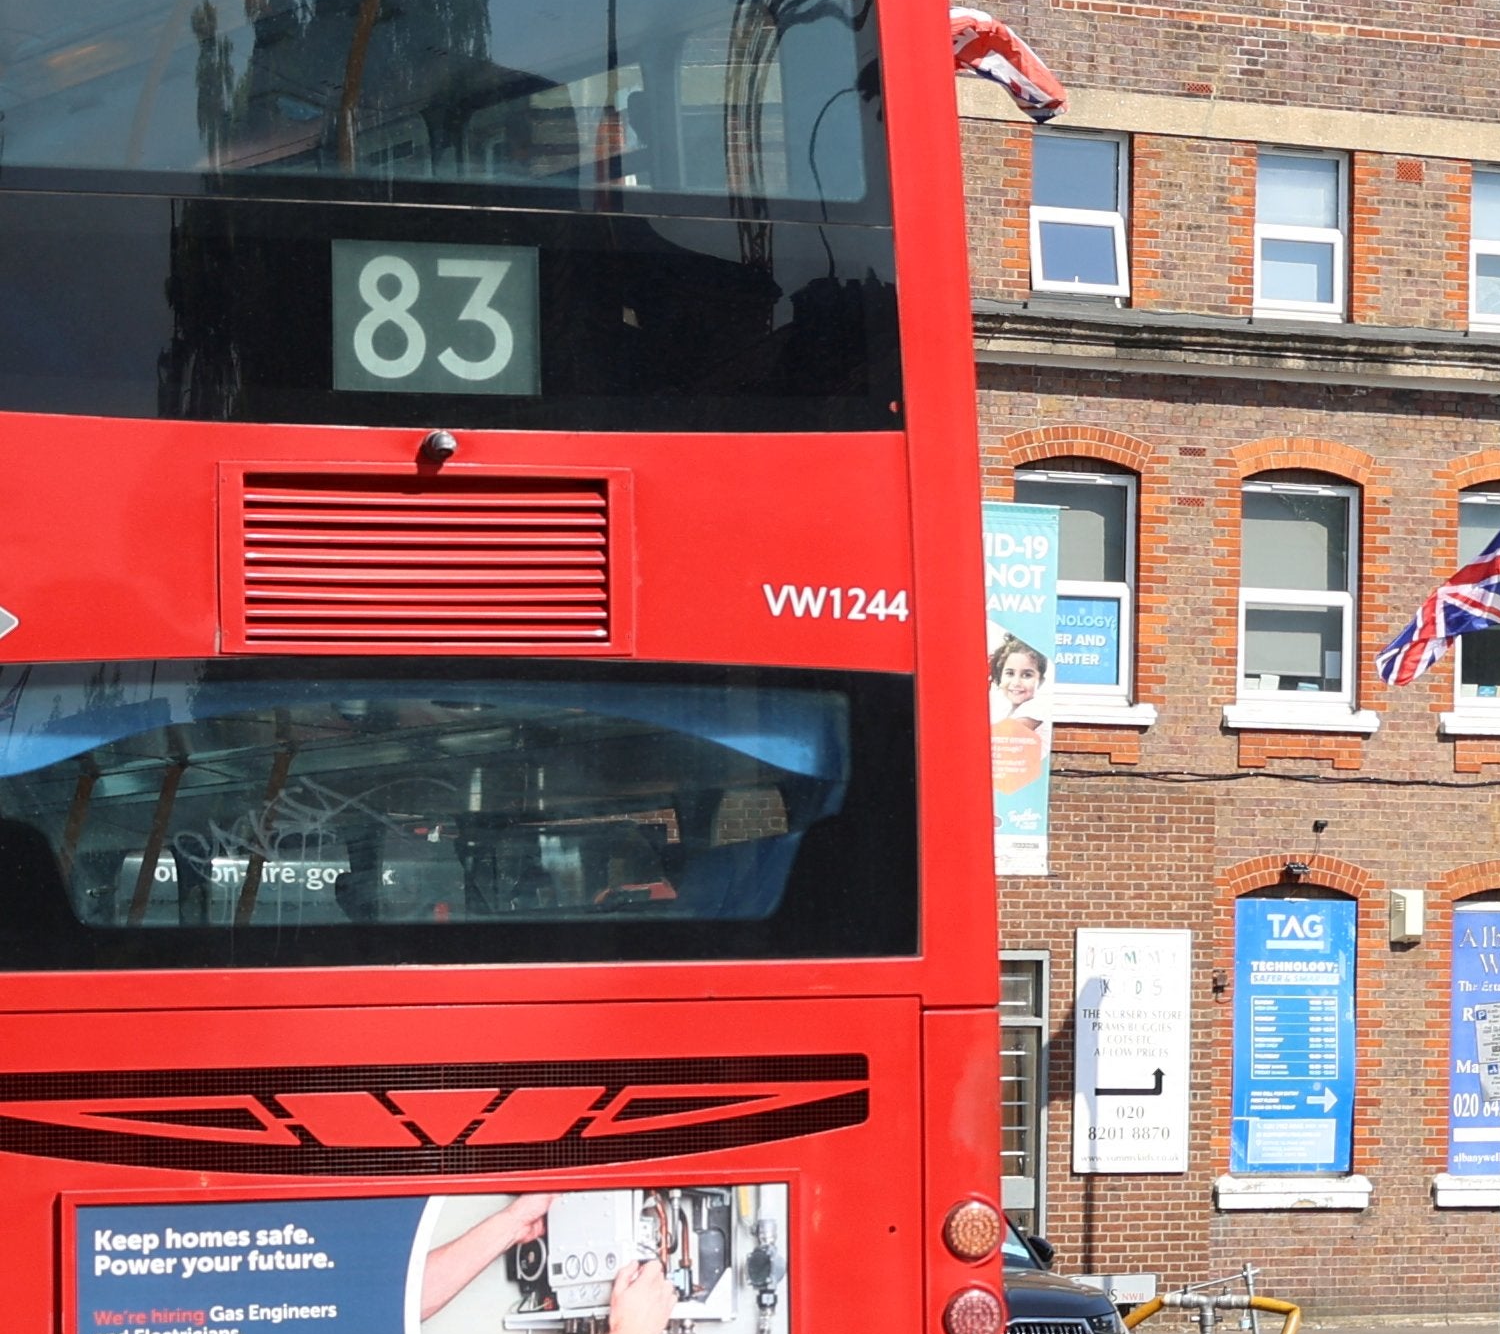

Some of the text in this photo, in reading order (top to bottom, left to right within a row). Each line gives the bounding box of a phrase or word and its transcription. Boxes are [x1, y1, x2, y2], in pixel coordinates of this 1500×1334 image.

[353, 254, 514, 381] 83
[985, 563, 1047, 589] NOT
[762, 583, 909, 622] VW1244
[986, 593, 1047, 613] AWAY
[1075, 634, 1106, 647] AND
[1267, 914, 1324, 938] TAG
[1082, 1009, 1182, 1020] THE NURSERY STORE
[1092, 1021, 1172, 1032] PRAMS BUGGIES
[1107, 1035, 1133, 1044] COTS
[1110, 1048, 1132, 1056] LOW
[1136, 1048, 1169, 1057] PRICES
[1117, 1106, 1145, 1119] 020
[1453, 1093, 1479, 1117] 020
[1089, 1126, 1170, 1140] 8201 8870
[94, 1224, 315, 1254] Keep homes safe.
[94, 1250, 335, 1278] Power your future.
[93, 1303, 337, 1326] We're hiring Gas Engineers
